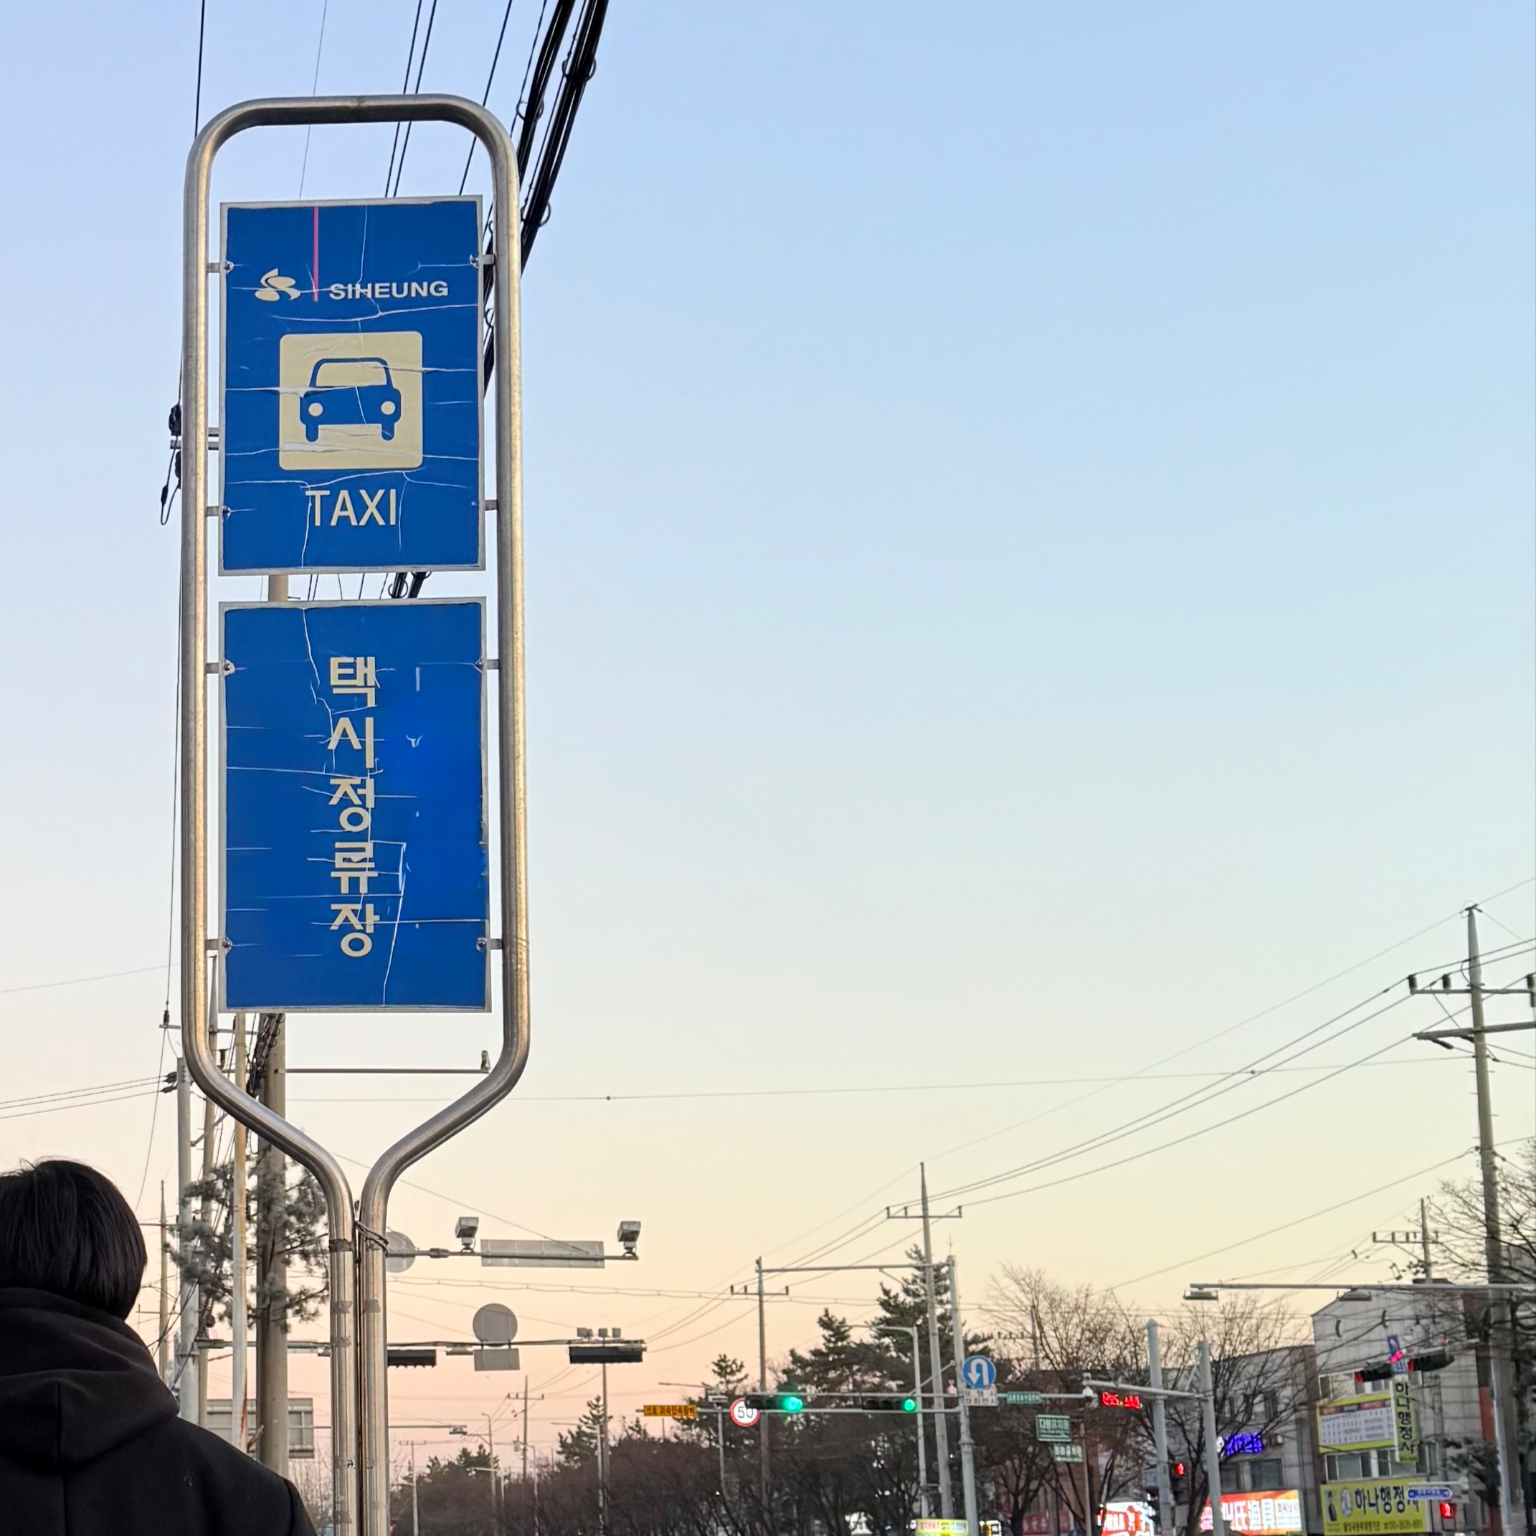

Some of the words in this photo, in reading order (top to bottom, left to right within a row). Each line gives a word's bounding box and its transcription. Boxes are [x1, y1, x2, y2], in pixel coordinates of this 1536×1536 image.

[330, 281, 449, 300] SIHEUNG
[305, 488, 398, 528] TAXI
[328, 655, 381, 959] 택시정류장
[737, 1405, 754, 1419] 50
